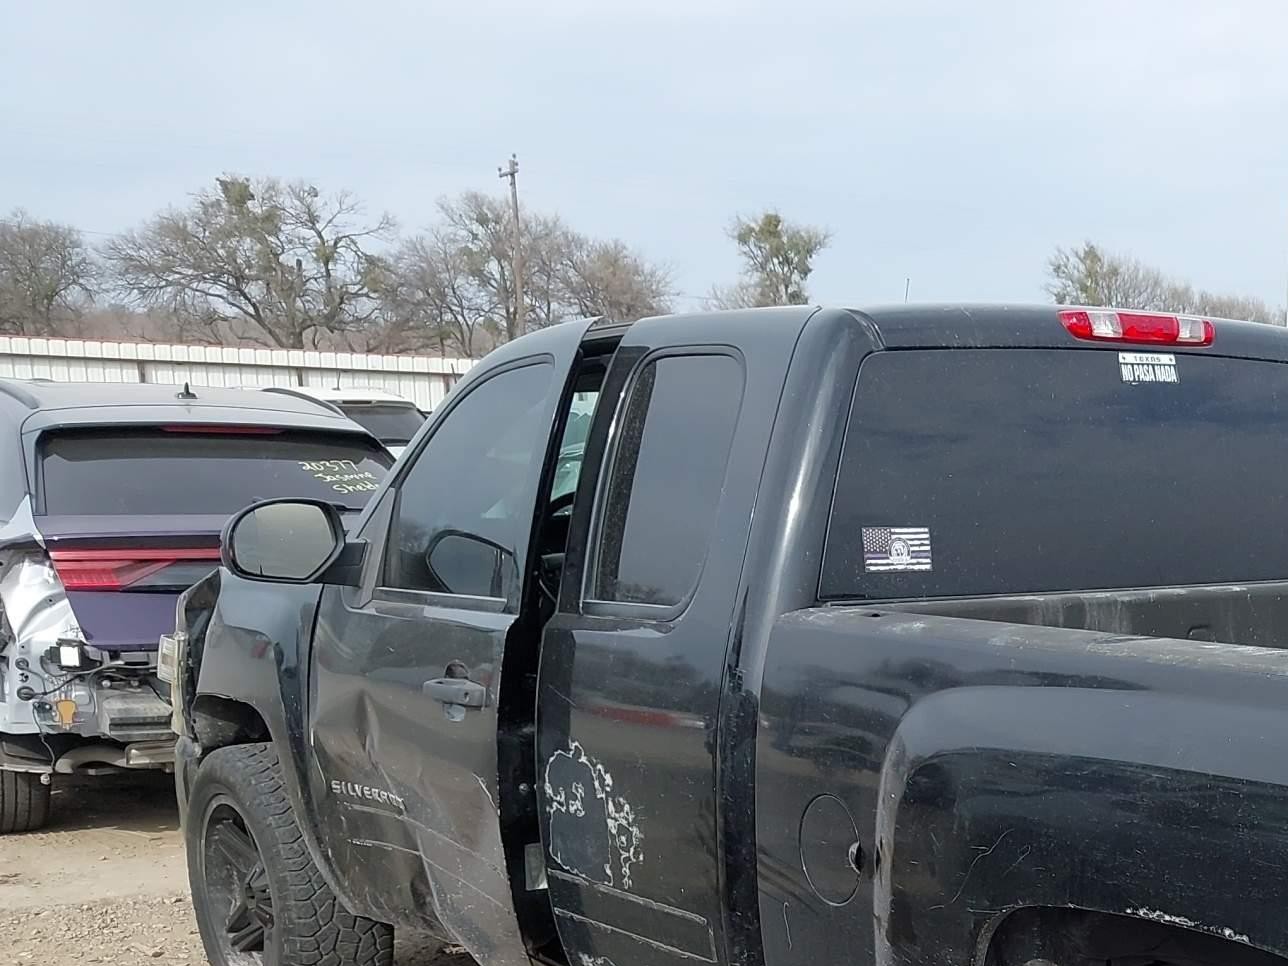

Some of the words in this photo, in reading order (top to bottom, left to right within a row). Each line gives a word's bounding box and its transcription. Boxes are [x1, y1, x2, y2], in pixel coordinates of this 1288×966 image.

[1121, 364, 1134, 381] NO
[1133, 364, 1156, 382] PASA
[1154, 365, 1178, 383] NADA
[298, 459, 359, 472] 20377
